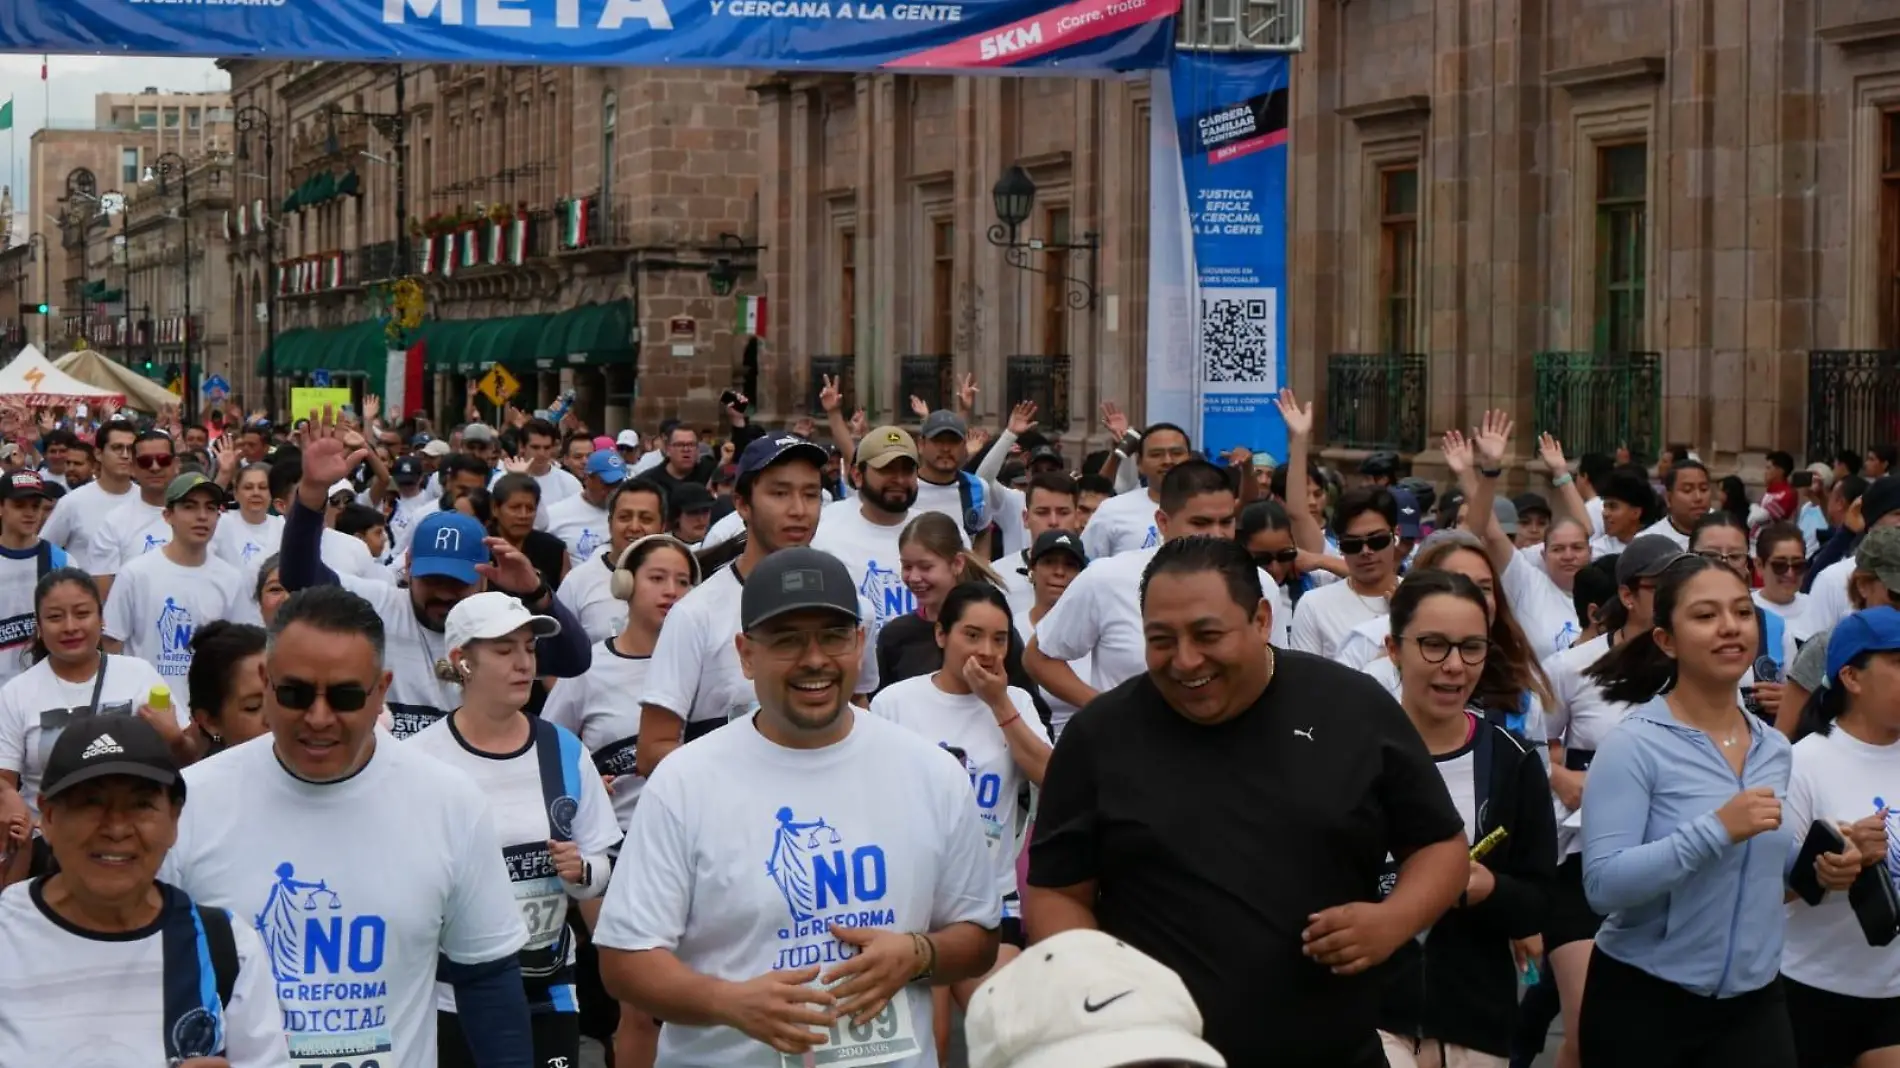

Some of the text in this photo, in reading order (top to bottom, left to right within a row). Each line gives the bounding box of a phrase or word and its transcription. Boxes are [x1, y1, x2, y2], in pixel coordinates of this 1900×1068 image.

[710, 0, 962, 21] Y CERCANA A LA GENTE
[980, 21, 1043, 60] 5KM
[1199, 106, 1252, 128] CARRERA
[1202, 116, 1255, 137] FAMILIAR
[1197, 189, 1253, 200] JUSTICIA
[1206, 201, 1250, 211] EFICAZ
[1201, 212, 1260, 223] CERCANA
[1204, 224, 1220, 235] LA
[1223, 224, 1264, 235] GENTE
[82, 745, 124, 760] adidas
[812, 845, 886, 909] NO
[777, 929, 789, 939] a
[794, 921, 809, 938] la
[304, 915, 385, 974] NO
[297, 980, 387, 1001] REFORMA
